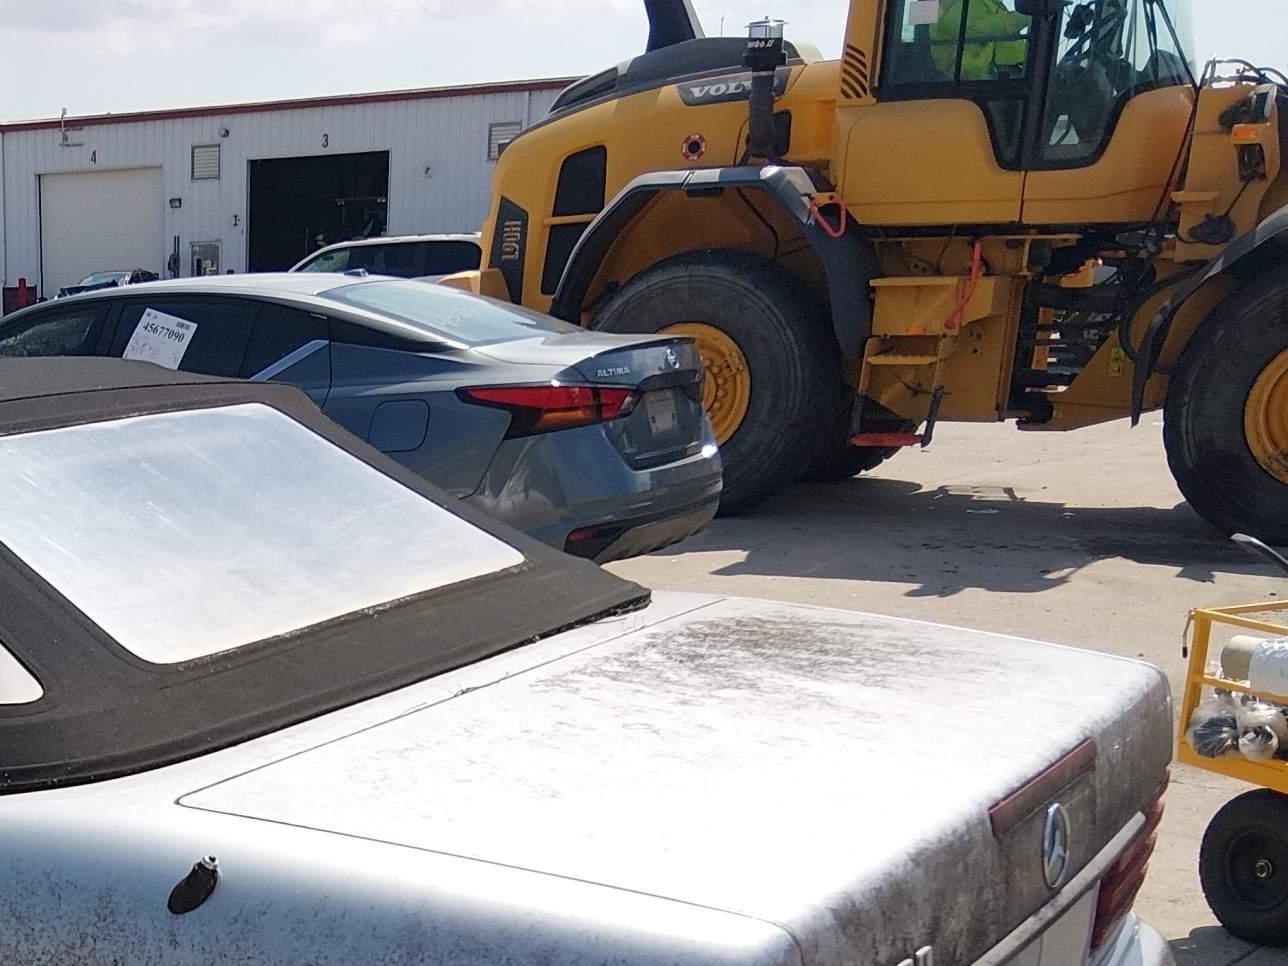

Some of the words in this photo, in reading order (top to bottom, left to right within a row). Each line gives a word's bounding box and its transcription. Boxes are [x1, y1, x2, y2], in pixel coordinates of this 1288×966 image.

[690, 76, 779, 99] VOL
[322, 134, 329, 148] 3
[90, 151, 97, 165] 4
[142, 322, 185, 343] 45677090
[596, 366, 631, 378] ALTIMA
